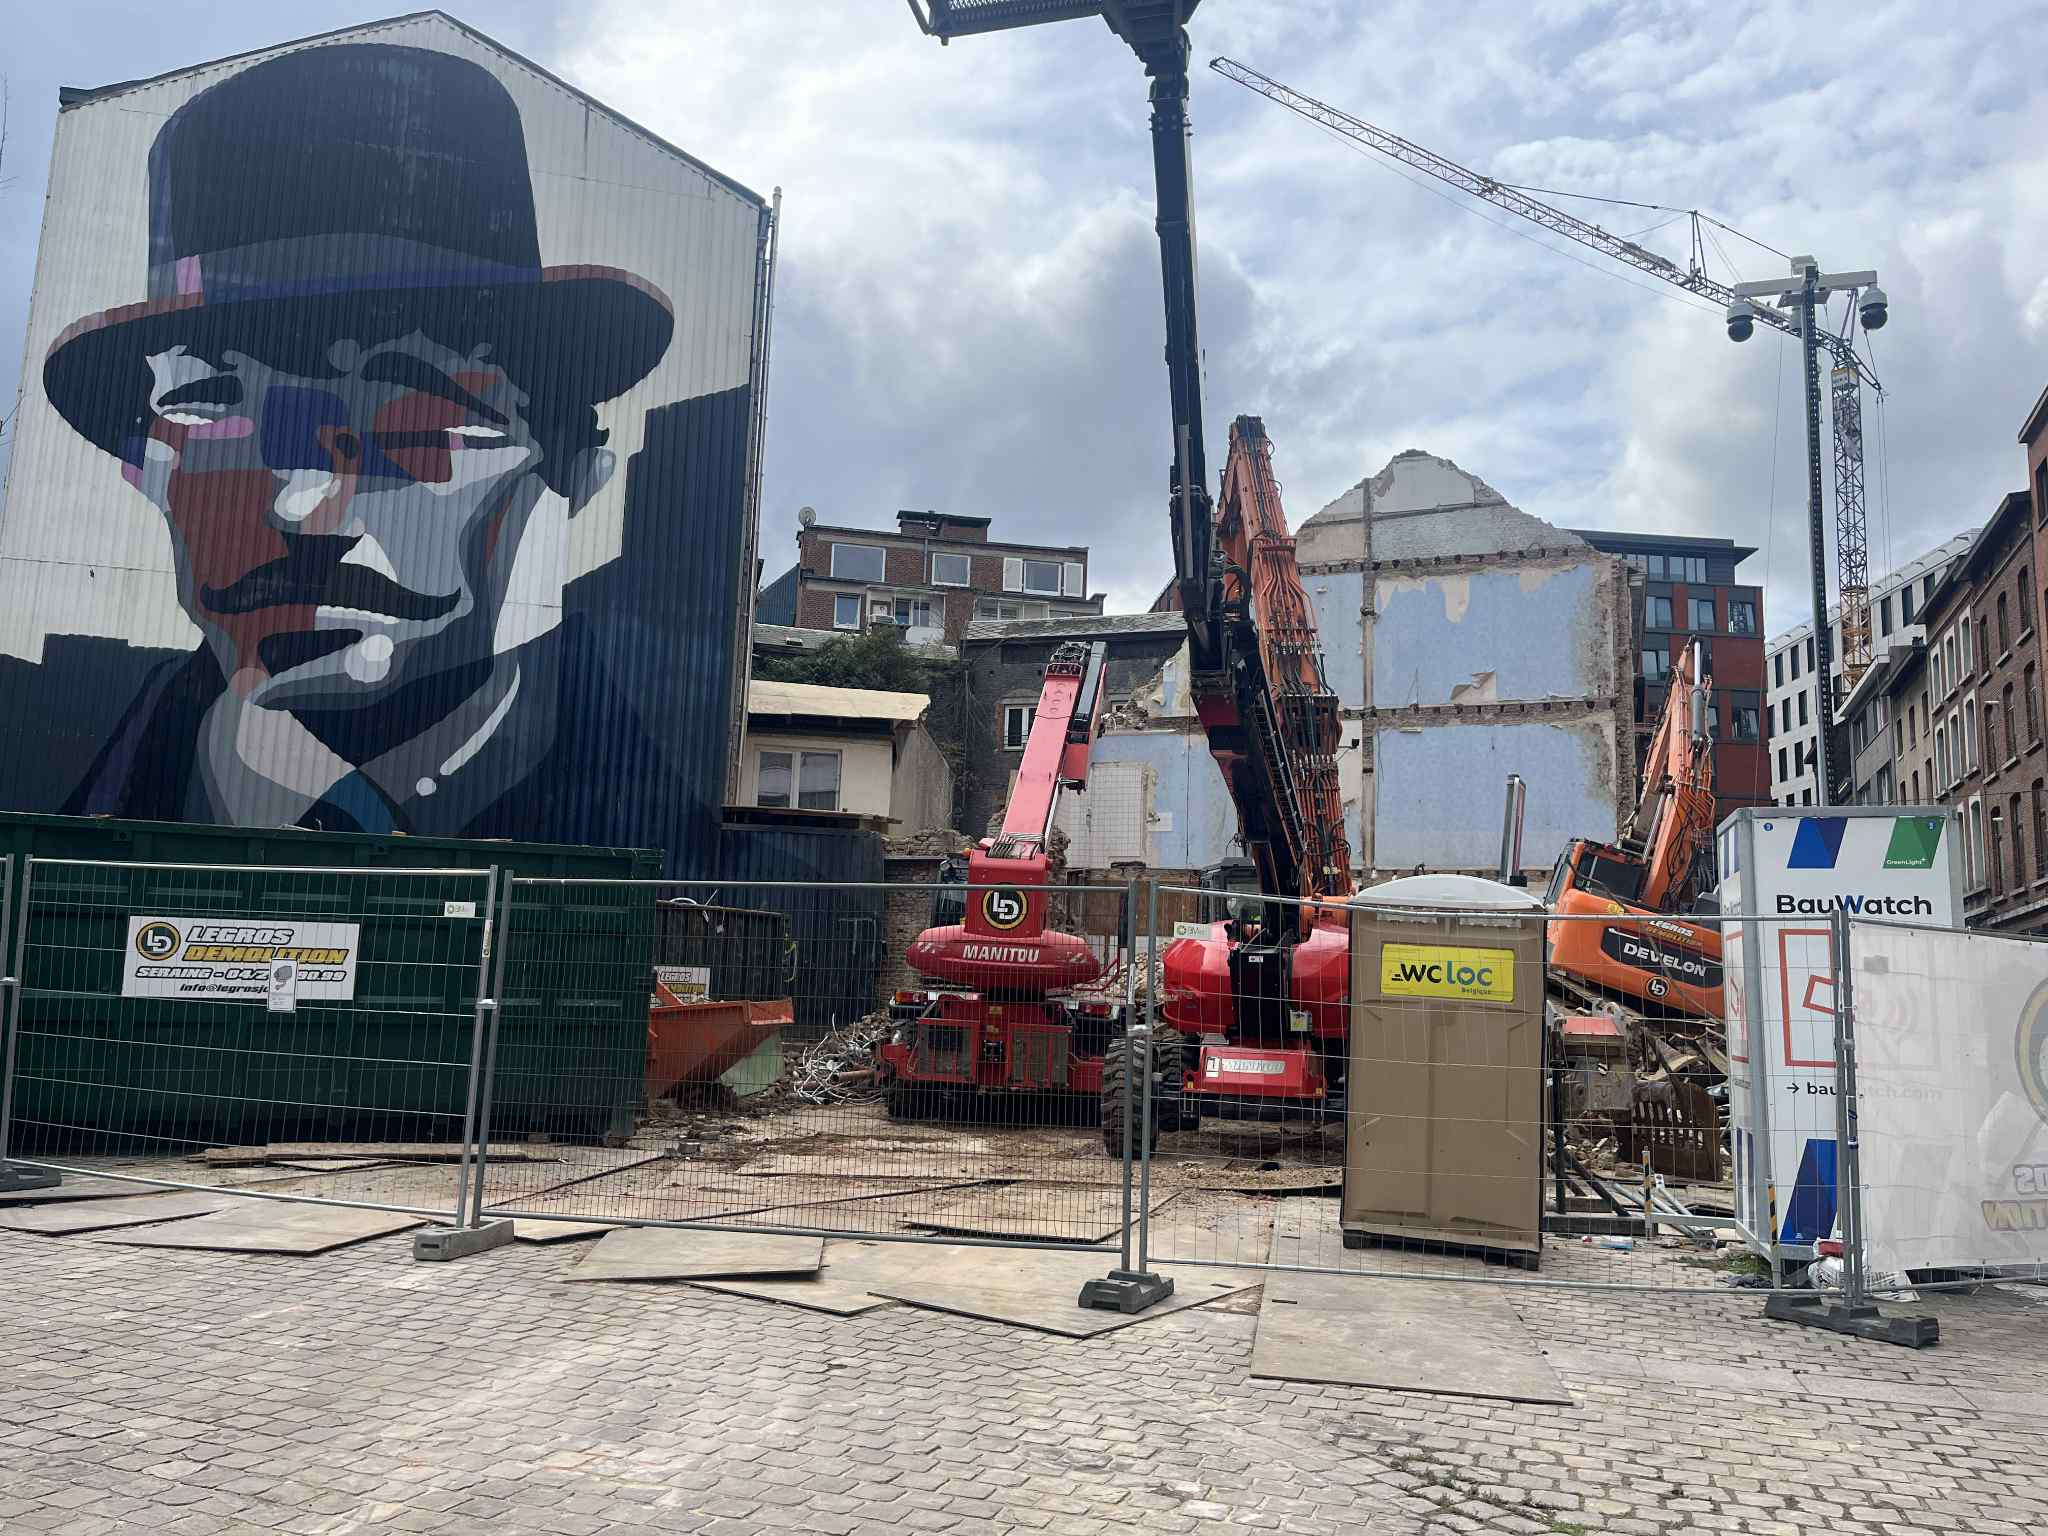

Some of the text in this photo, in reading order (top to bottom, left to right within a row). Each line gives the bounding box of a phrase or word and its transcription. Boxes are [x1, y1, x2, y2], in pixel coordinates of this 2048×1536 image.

[1776, 895, 1932, 915] BauWatch
[185, 926, 295, 945] LEGROS
[182, 945, 350, 965] DEMOLITION
[962, 945, 1040, 963] MANITOU
[1623, 942, 1707, 977] DEVELON
[135, 966, 213, 980] SERAING
